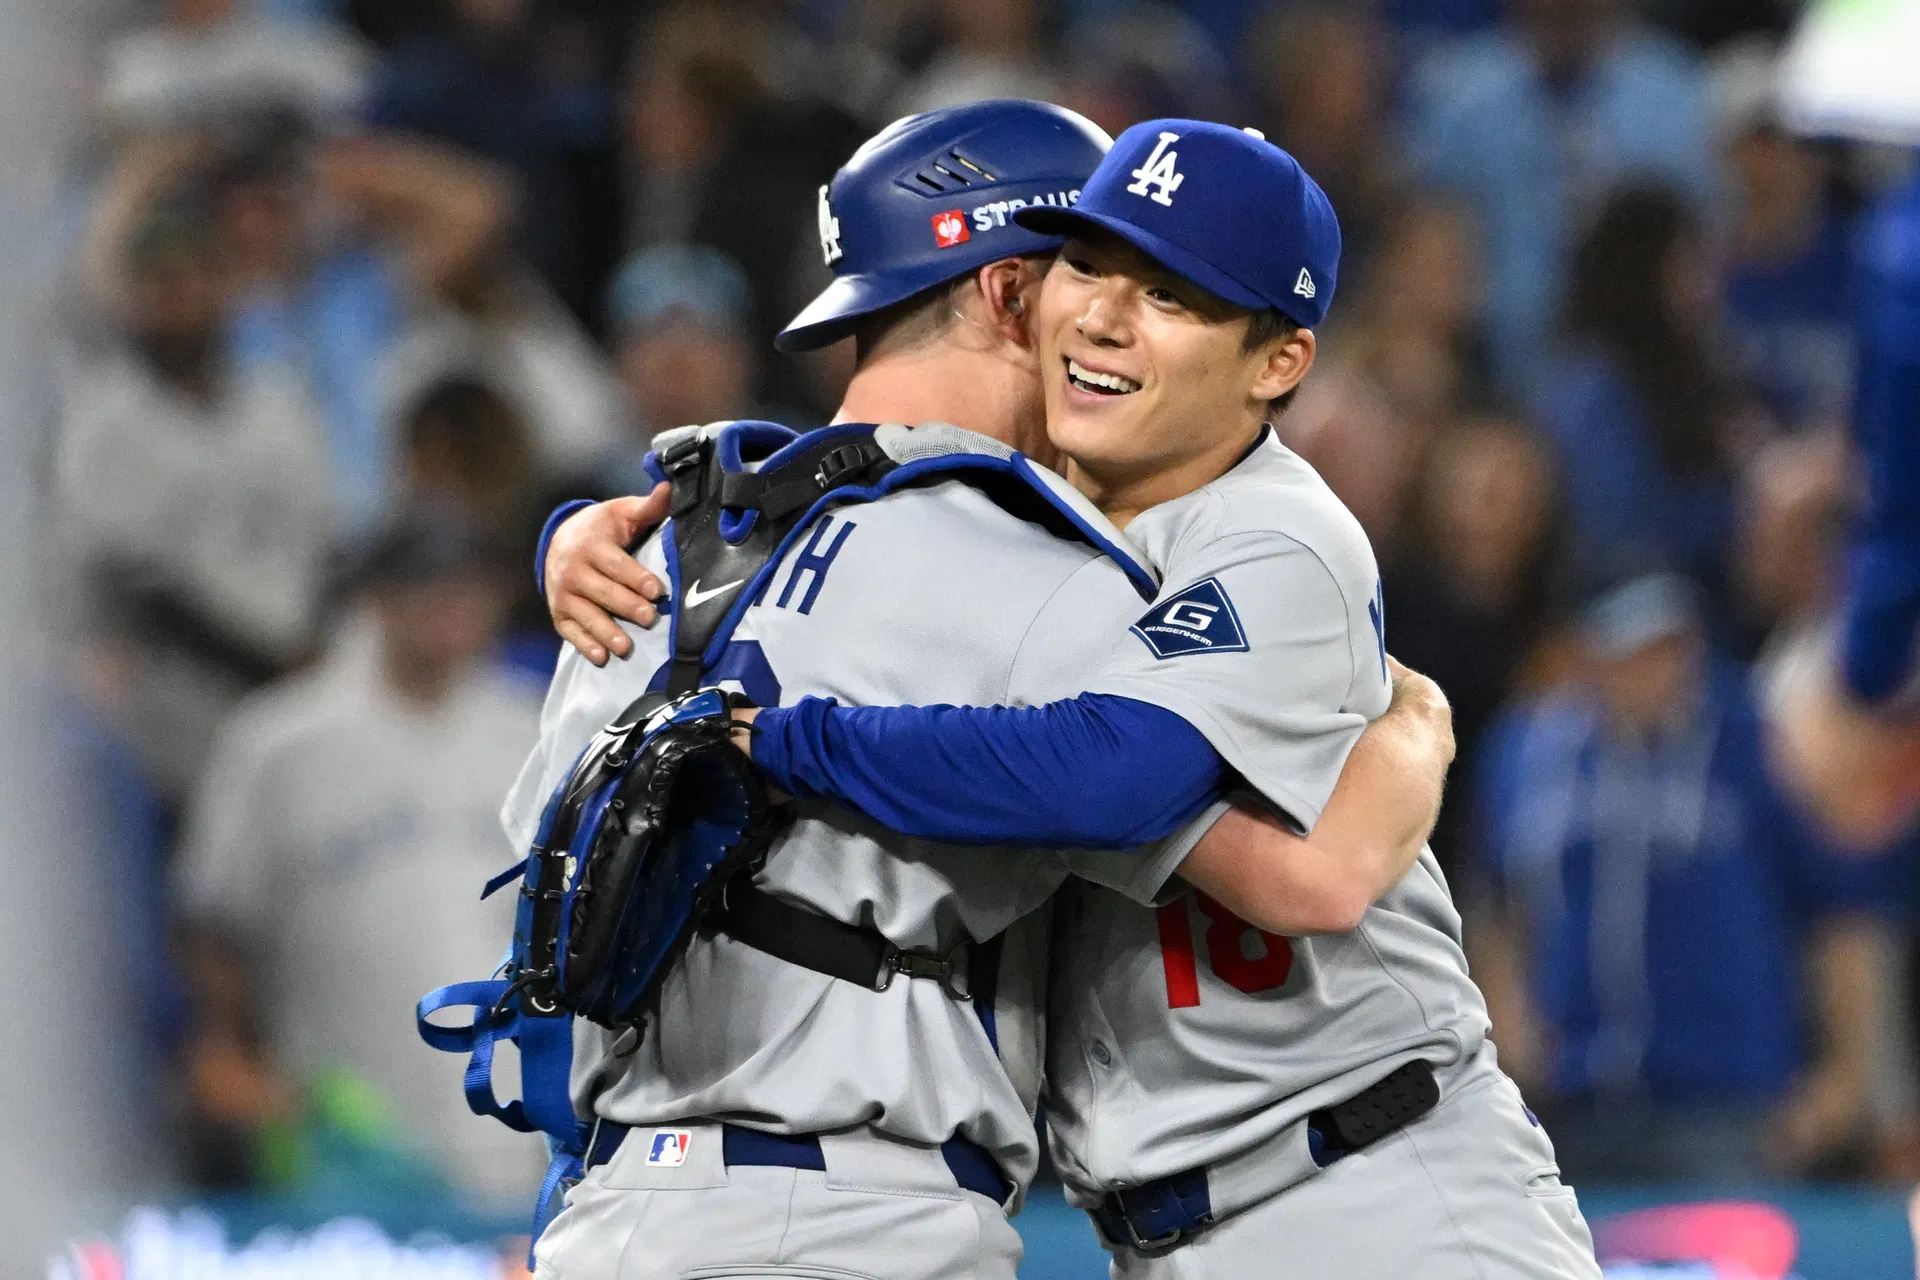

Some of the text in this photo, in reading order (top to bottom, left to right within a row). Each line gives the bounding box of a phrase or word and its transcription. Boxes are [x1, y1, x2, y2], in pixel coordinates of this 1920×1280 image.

[1127, 132, 1185, 207] LA
[1163, 600, 1220, 631] G
[1144, 626, 1213, 647] GUGGENHEIM
